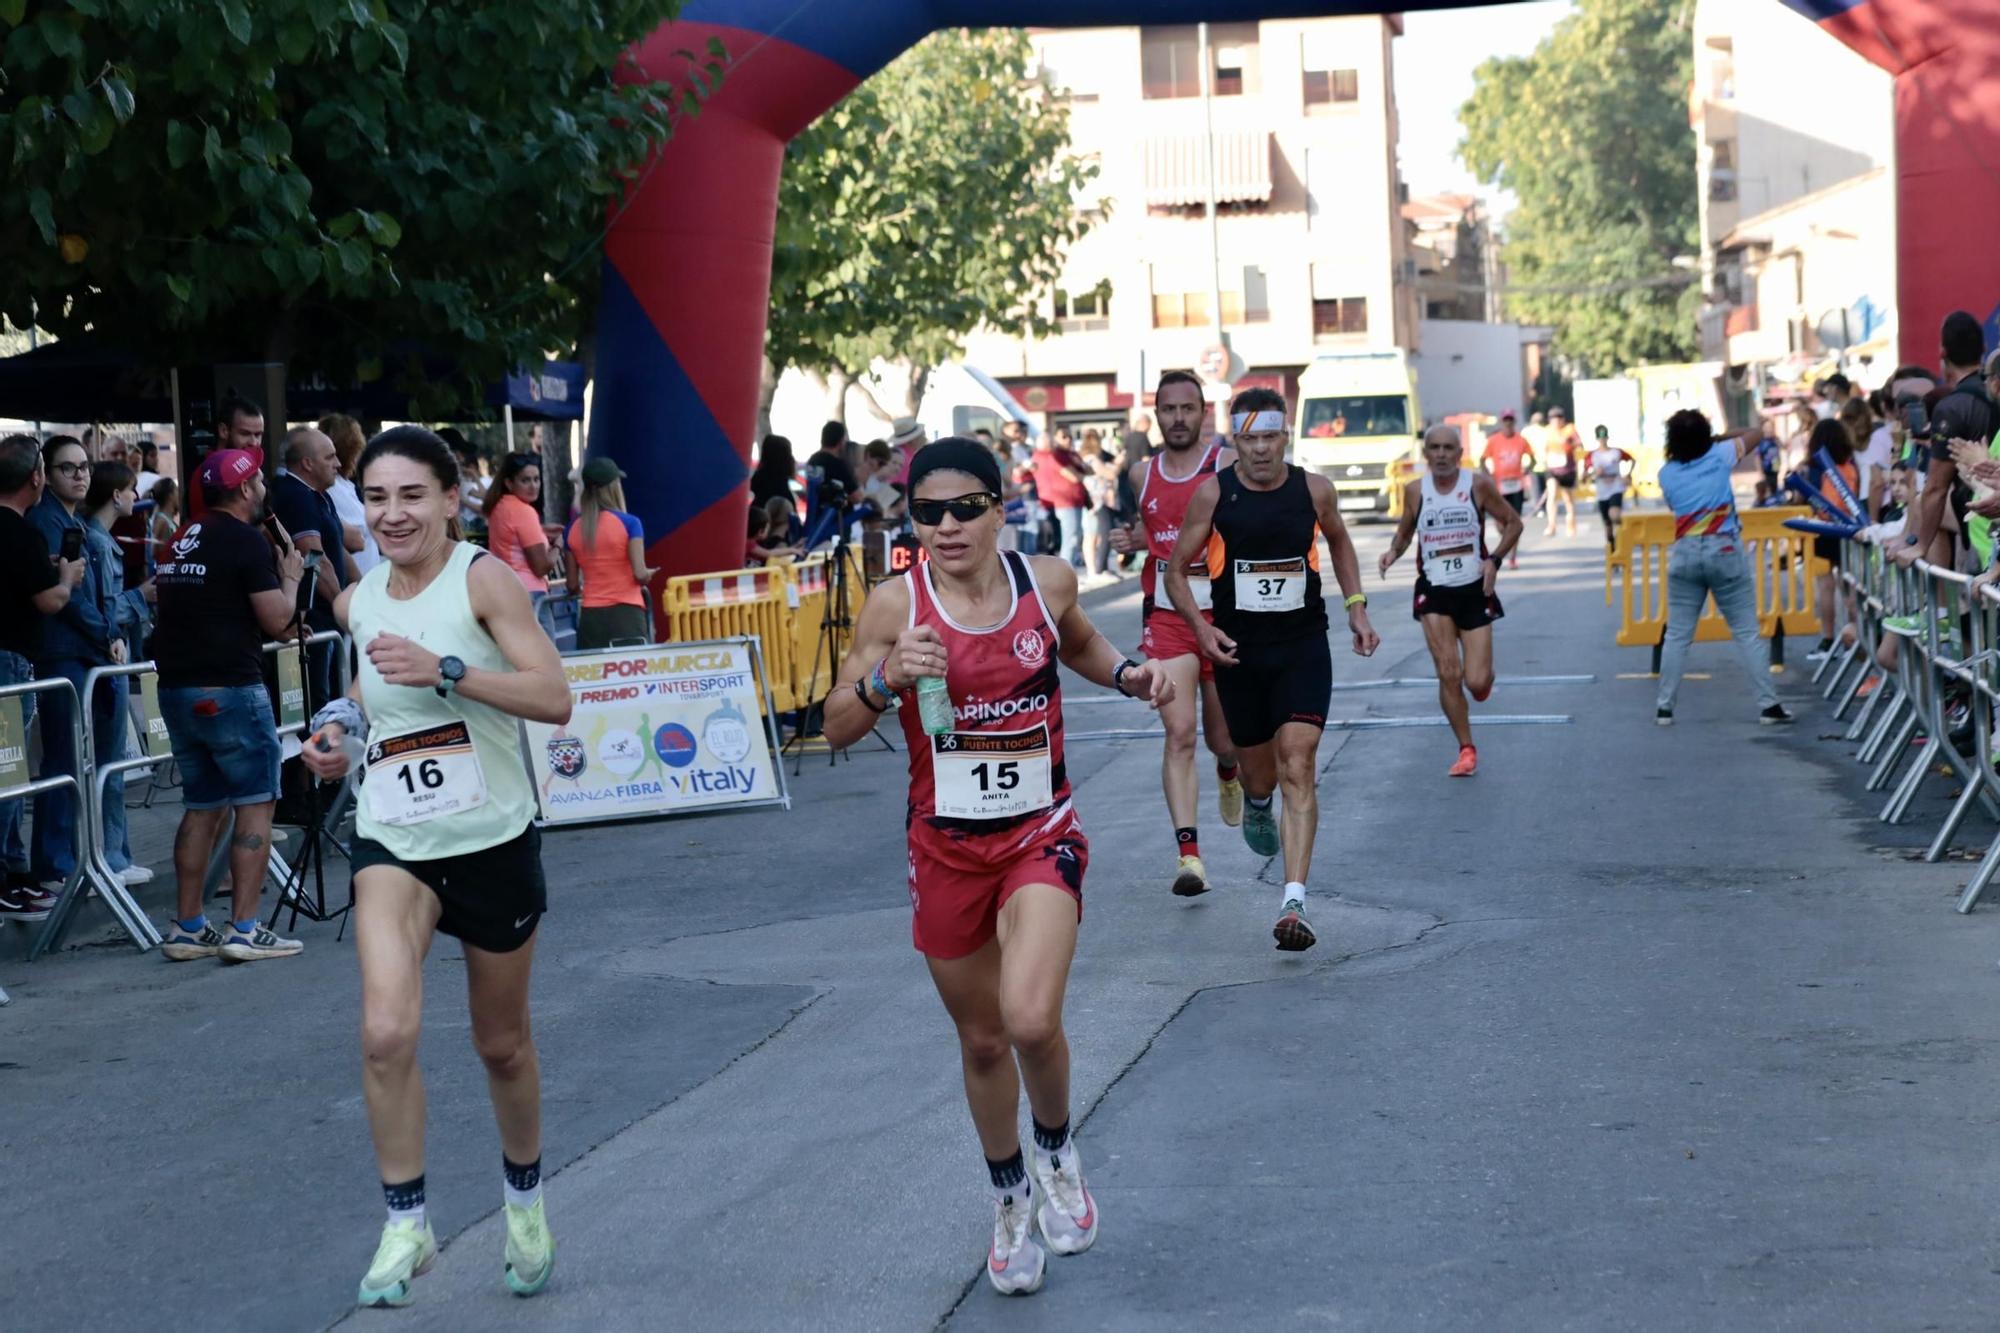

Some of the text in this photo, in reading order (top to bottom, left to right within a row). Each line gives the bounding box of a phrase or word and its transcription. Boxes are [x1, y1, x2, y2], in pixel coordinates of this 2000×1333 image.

[1442, 558, 1463, 571] 78
[1257, 578, 1287, 596] 37
[580, 674, 745, 705] PREMIO INTERSPORT
[953, 694, 1048, 721] ARINOCIO
[941, 735, 957, 749] 36
[963, 740, 1002, 750] PUENTE
[1004, 731, 1044, 749] TOCINOS
[398, 758, 444, 794] 16
[671, 765, 756, 794] vitaly
[971, 761, 1020, 791] 15
[616, 780, 663, 799] FIBRA
[982, 792, 1010, 801] ANITA
